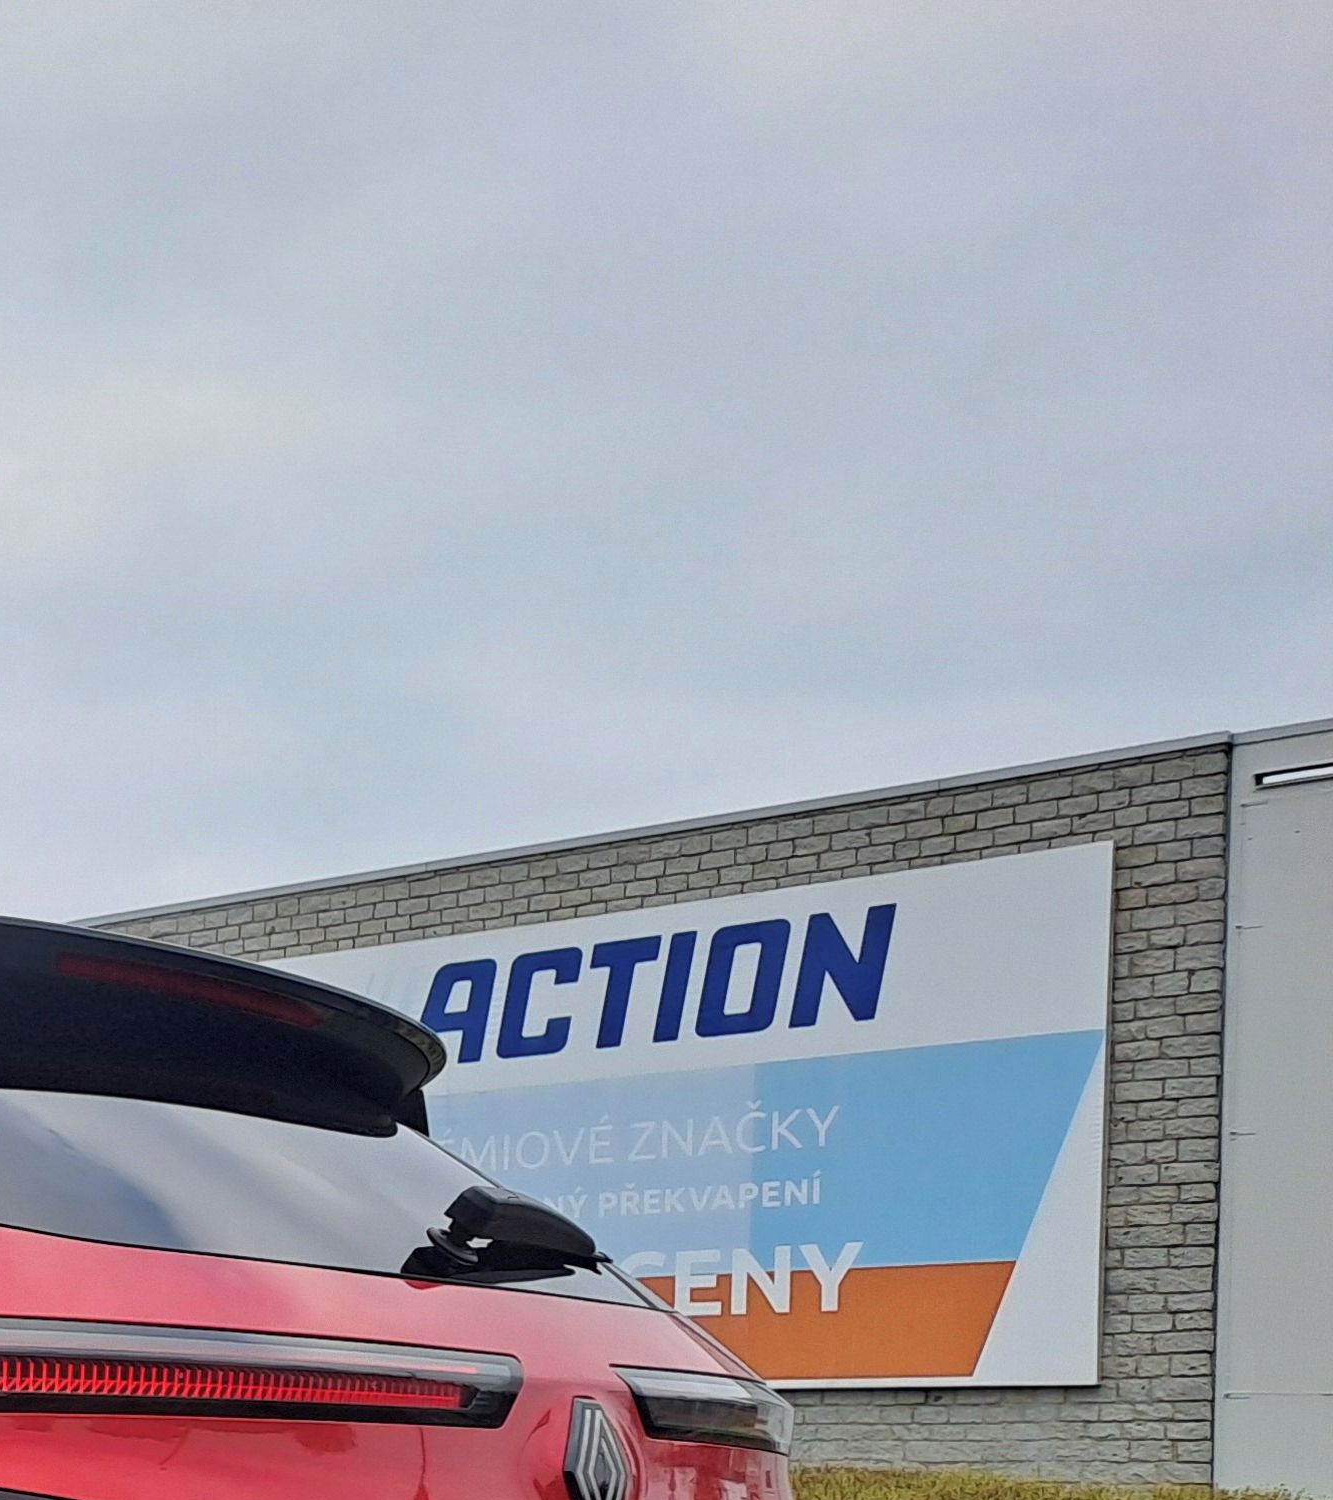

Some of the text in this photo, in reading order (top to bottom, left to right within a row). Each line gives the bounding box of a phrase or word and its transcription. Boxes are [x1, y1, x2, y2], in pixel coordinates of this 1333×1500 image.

[420, 903, 897, 1062] ACTION
[628, 1101, 841, 1162] ZNAČKY
[599, 1169, 822, 1218] PŘEKVAPENÍ
